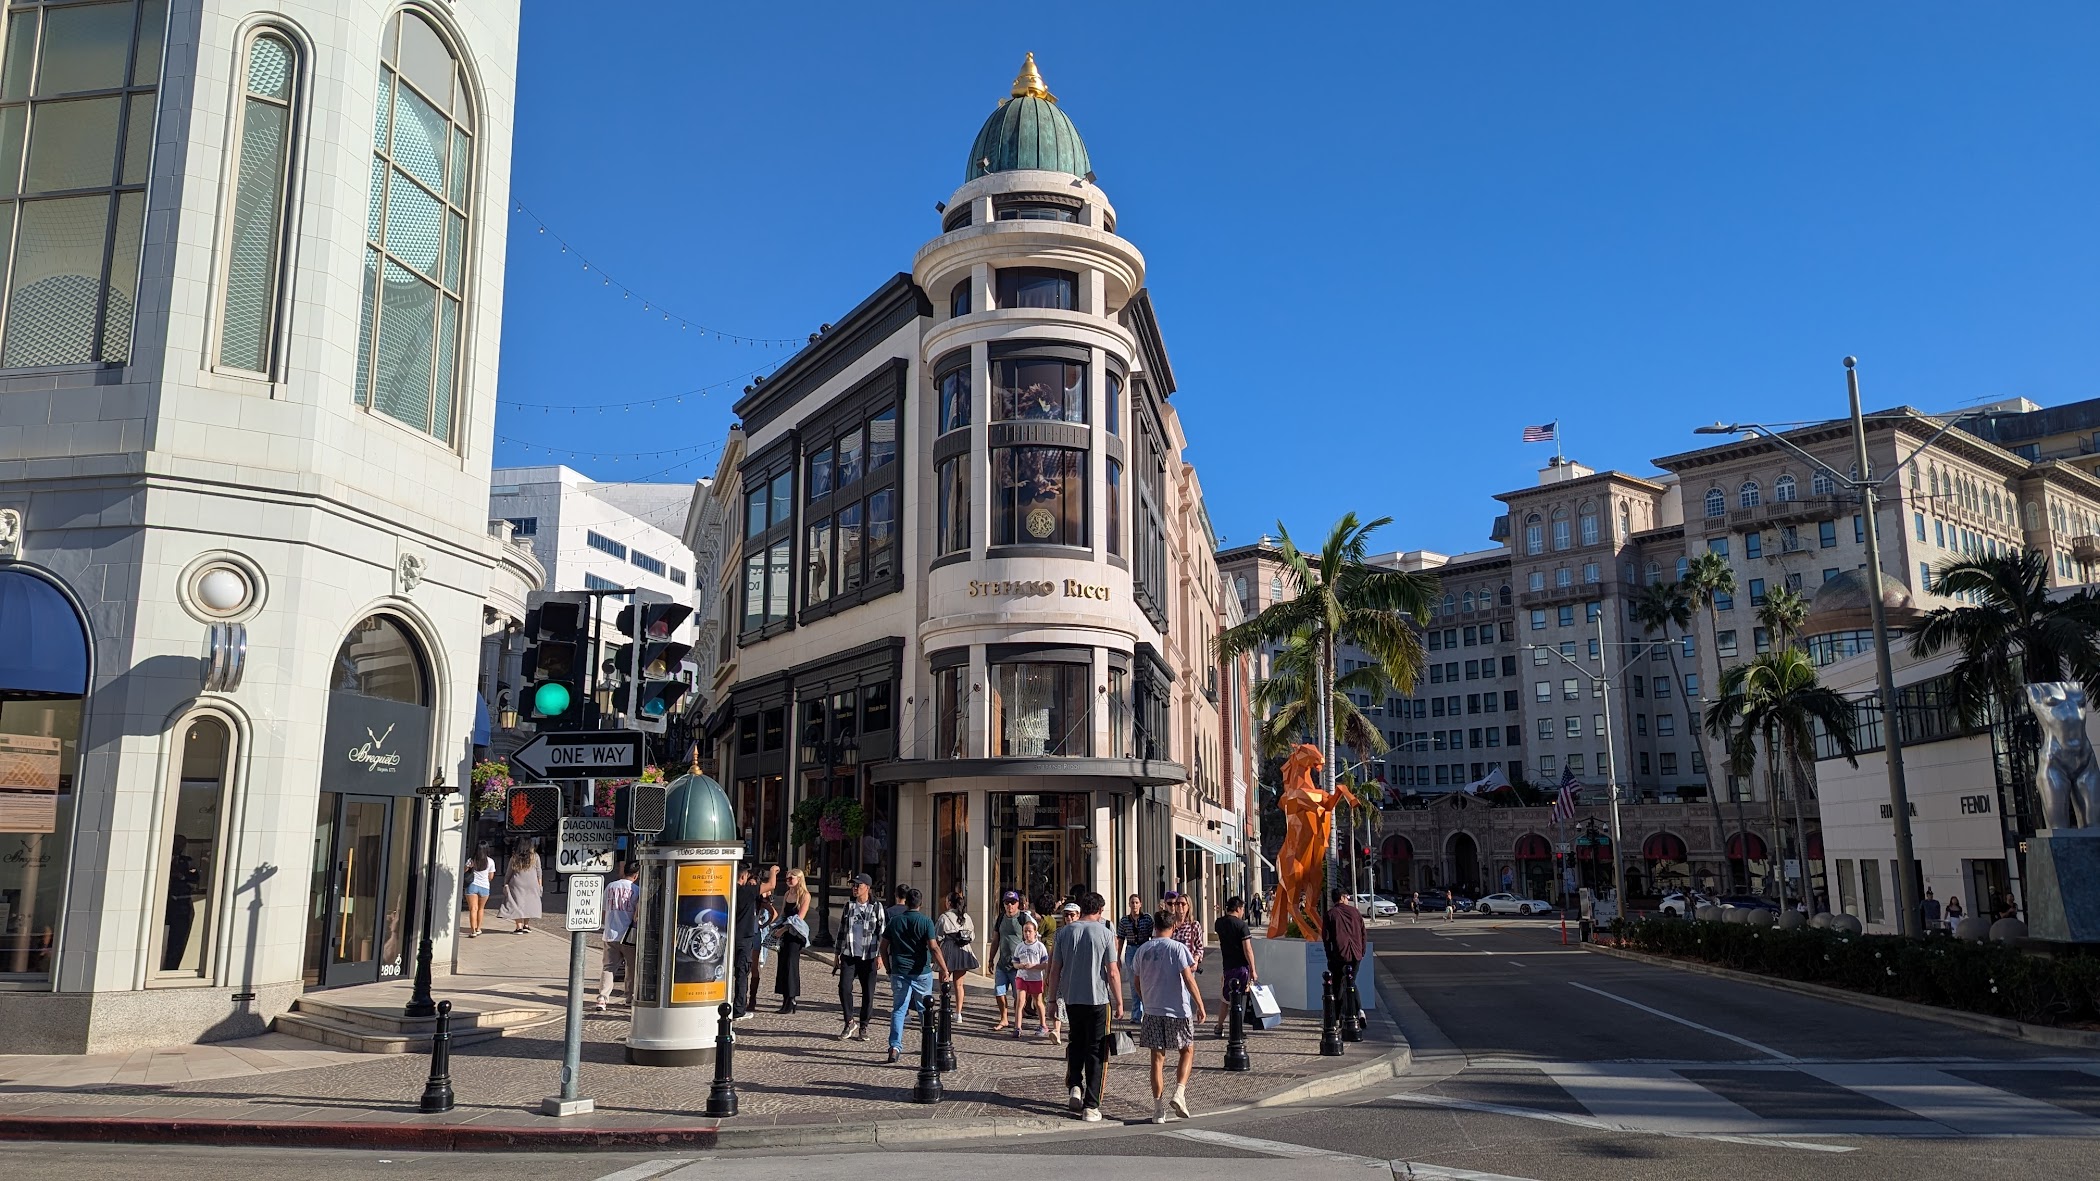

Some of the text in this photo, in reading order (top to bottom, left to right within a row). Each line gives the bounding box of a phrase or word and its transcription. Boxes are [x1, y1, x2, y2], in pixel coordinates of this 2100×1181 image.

[968, 578, 1111, 602] STEFANO RICCI
[348, 742, 400, 772] Breguet
[551, 746, 626, 764] ONE WAY
[1961, 794, 1991, 814] FENDI
[562, 820, 612, 830] DIAGONAL
[561, 832, 612, 842] CROSSING
[677, 848, 695, 856] TWO
[560, 849, 580, 866] OK
[576, 889, 595, 897] ONLY
[575, 908, 595, 916] WALK
[570, 917, 597, 925] SIGNAL
